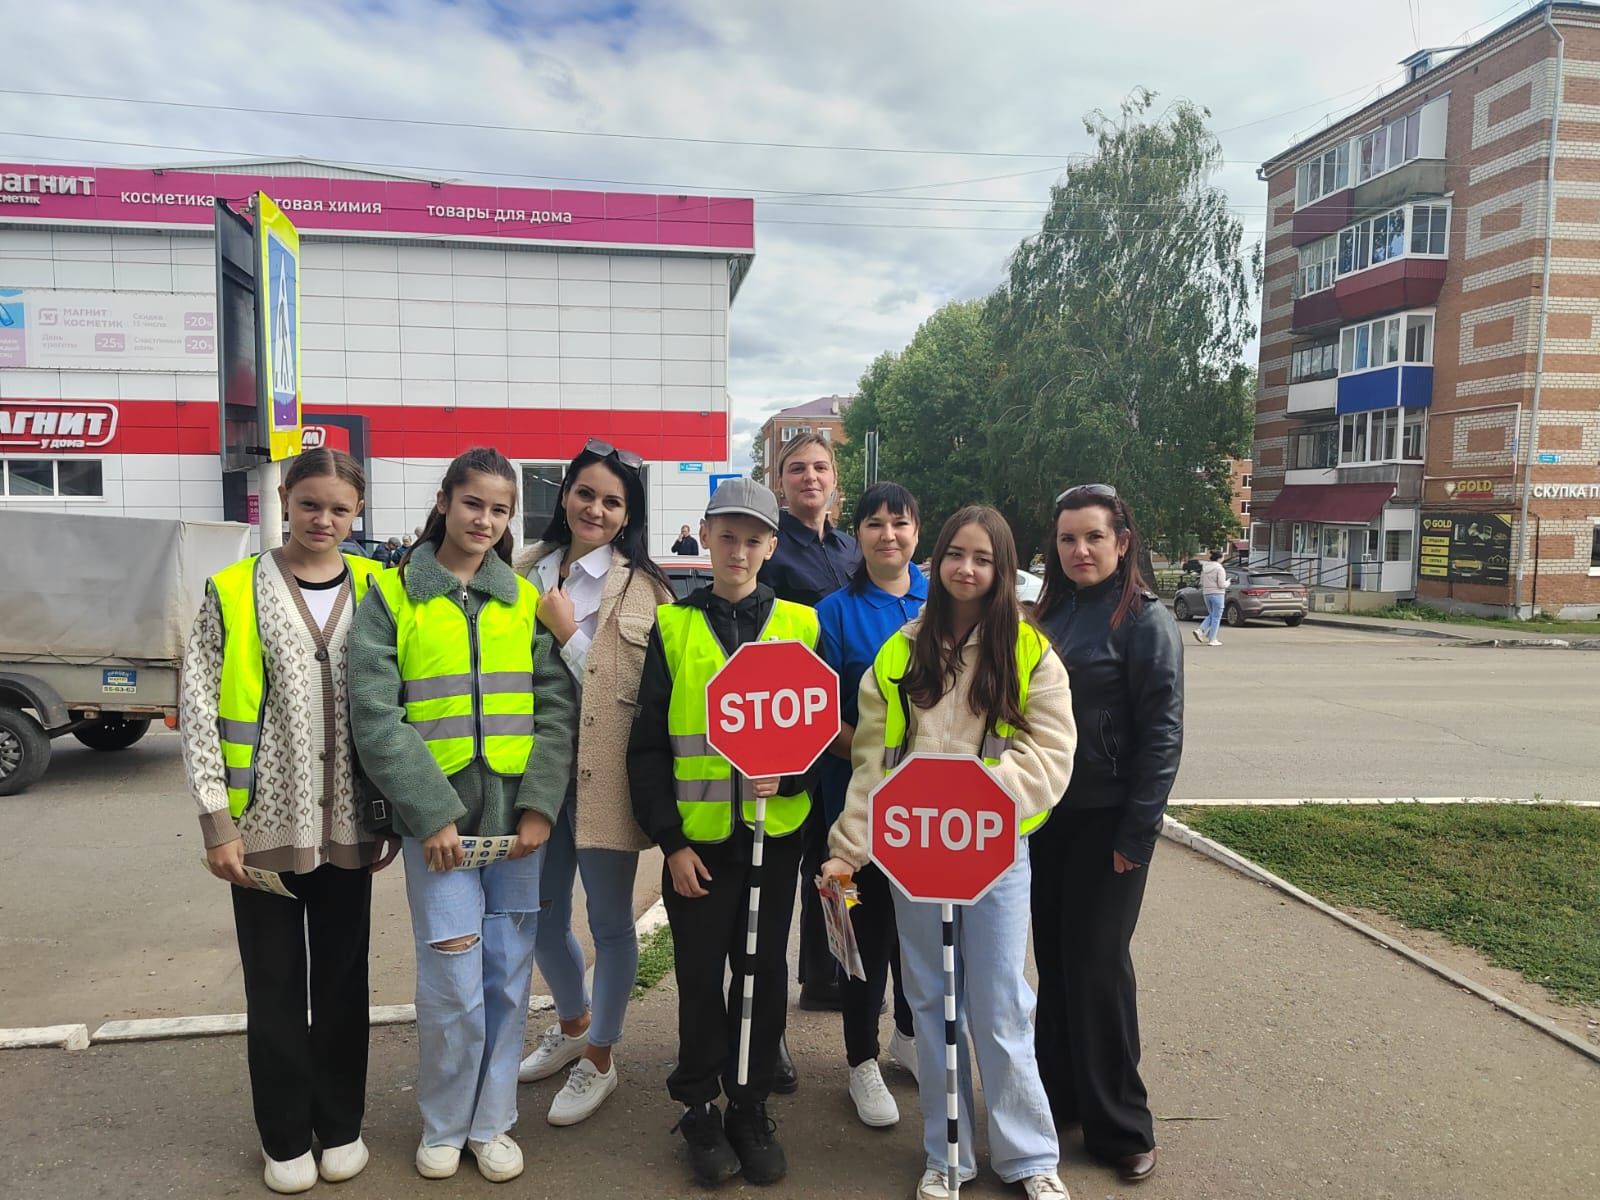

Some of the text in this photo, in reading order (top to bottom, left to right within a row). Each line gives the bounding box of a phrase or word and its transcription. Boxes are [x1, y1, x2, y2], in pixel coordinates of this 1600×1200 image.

[121, 190, 215, 207] косметика
[328, 202, 382, 214] химия
[426, 205, 572, 223] товары для дома
[63, 308, 107, 317] МАГНИТ
[63, 319, 123, 328] КОСМЕТИК
[40, 439, 85, 449] у дома
[1457, 480, 1492, 492] GOLD
[1534, 486, 1586, 498] СКУПКА
[1432, 519, 1452, 528] GOLD
[719, 687, 828, 733] STOP
[883, 805, 1003, 851] STOP
